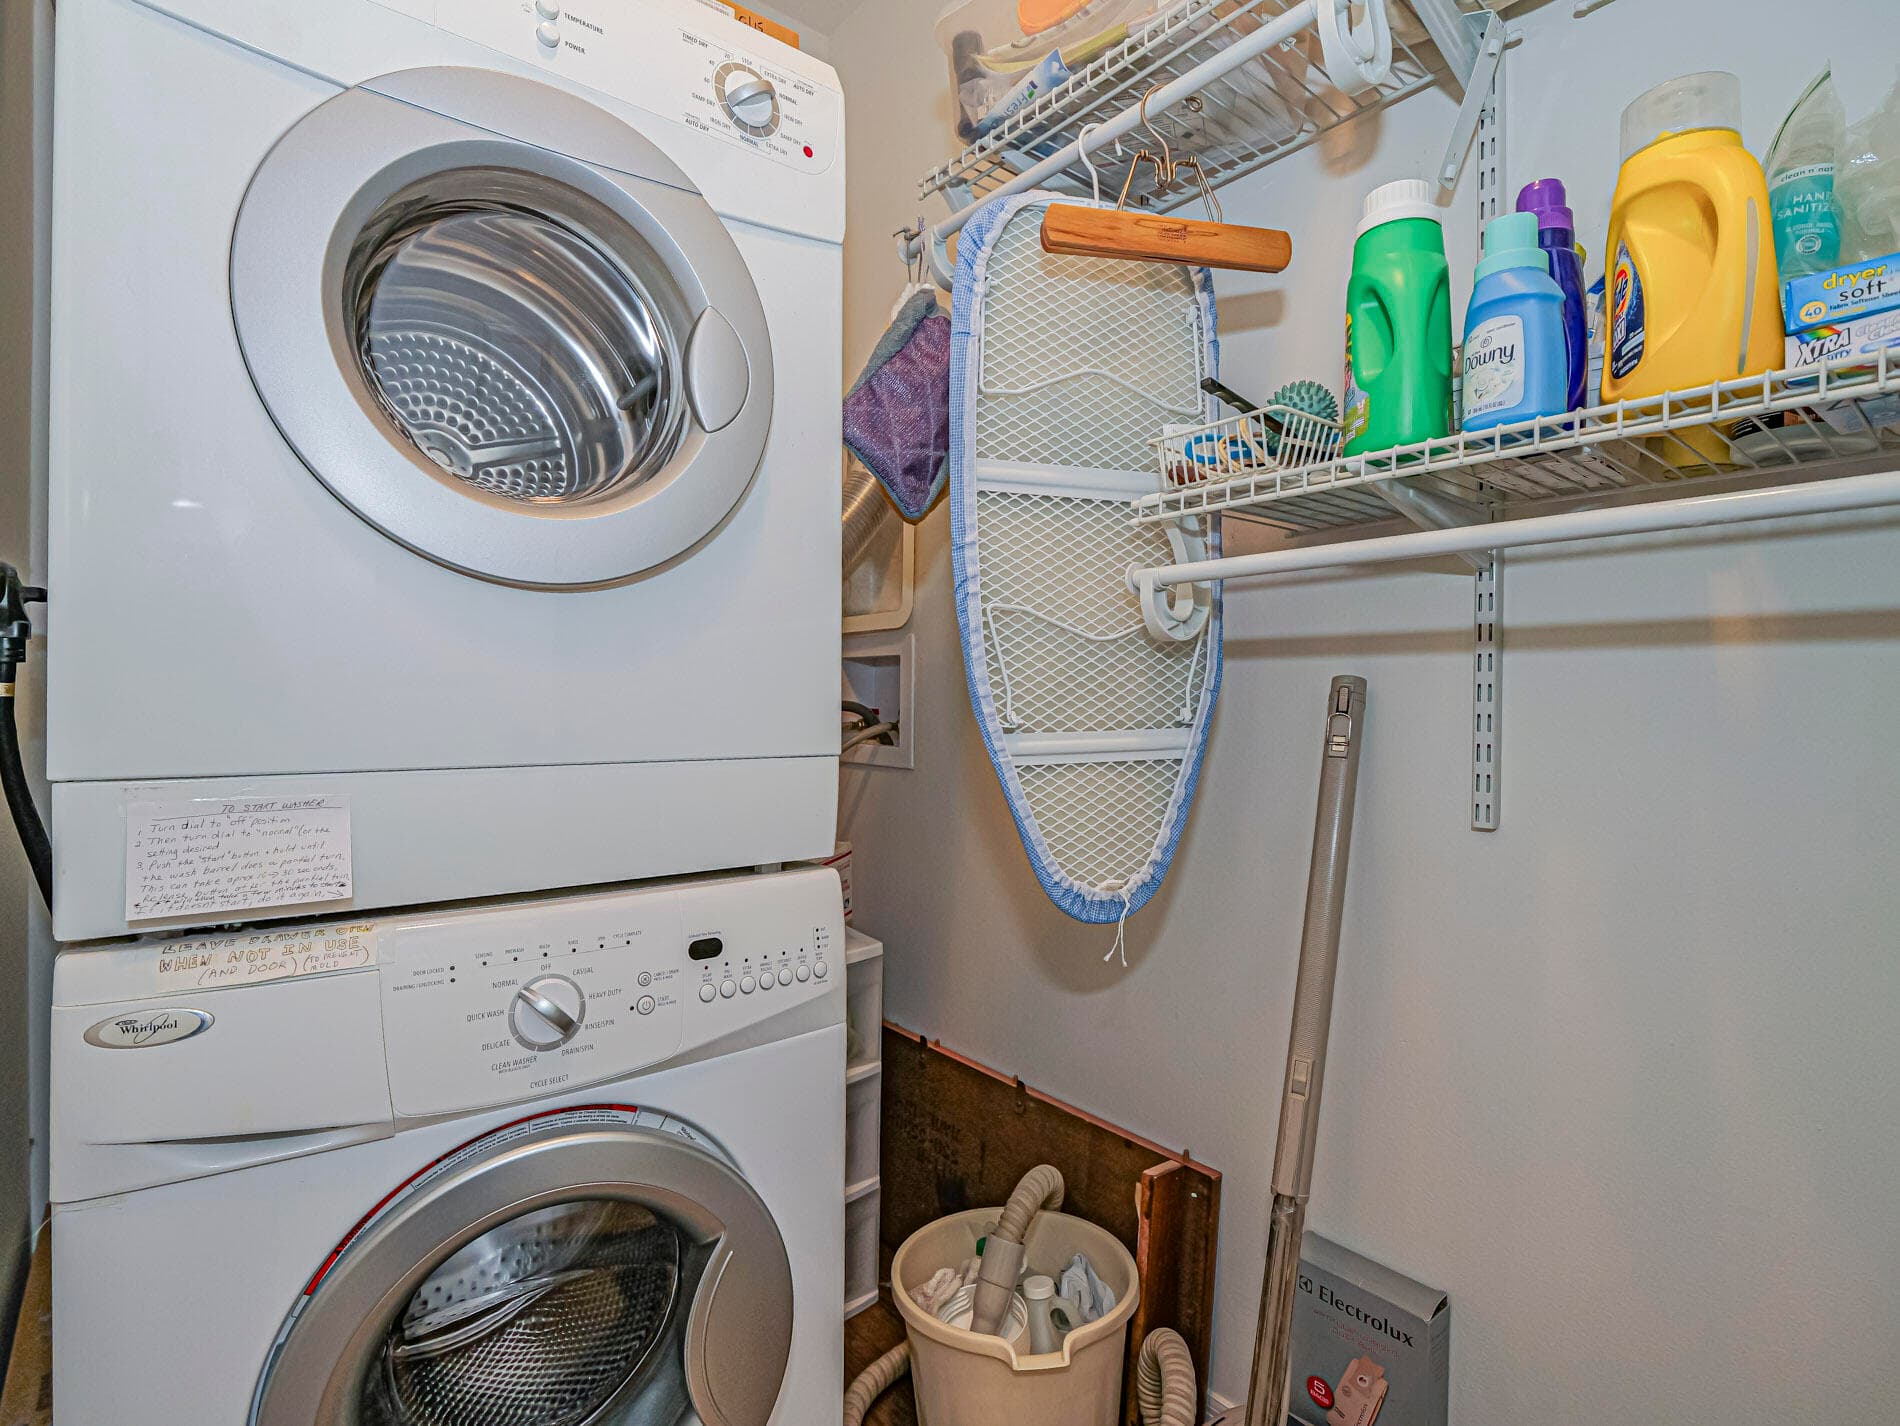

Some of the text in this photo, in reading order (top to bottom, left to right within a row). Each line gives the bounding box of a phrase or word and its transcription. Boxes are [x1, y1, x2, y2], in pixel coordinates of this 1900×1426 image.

[564, 12, 604, 35] TEMPERATURE
[682, 32, 698, 44] TIMED
[564, 40, 586, 54] POWER
[793, 83, 805, 92] AUTO
[779, 92, 798, 105] NORMAL
[685, 118, 709, 132] AUTO DRY
[1781, 170, 1806, 182] clean
[1823, 264, 1888, 290] dryer
[1840, 280, 1887, 301] soft
[1804, 306, 1822, 317] 40
[1795, 327, 1851, 367] XTRA
[1465, 344, 1514, 374] Downy
[220, 799, 325, 814] TO START WASHER
[149, 823, 175, 832] Turn
[181, 818, 205, 829] dial
[210, 818, 221, 828] to
[251, 816, 290, 828] position
[146, 837, 177, 845] Then
[182, 834, 207, 842] turn
[211, 830, 235, 839] dial
[241, 829, 251, 837] to
[147, 841, 219, 860] setting desired
[149, 860, 171, 870] Push
[273, 844, 297, 854] hold
[300, 841, 325, 850] until
[143, 873, 164, 881] the
[169, 868, 197, 879] wash
[203, 861, 239, 875] barrel
[141, 884, 164, 892] This
[194, 879, 221, 888] take
[160, 935, 363, 973] WHEN NOT IN USE
[162, 938, 238, 954] LEAVE
[572, 967, 594, 976] CASUAL
[492, 978, 519, 989] NORMAL
[588, 988, 622, 999] HEAVY DUTY
[466, 1009, 505, 1022] QUICK WASH
[119, 1018, 178, 1037] Whirlpool
[481, 1039, 510, 1051] DELICATE
[491, 1055, 537, 1071] CLEAN WASHER
[530, 1073, 569, 1089] CYCLE SELECT
[1319, 1285, 1416, 1349] Electrolux
[1313, 1380, 1326, 1396] 5
